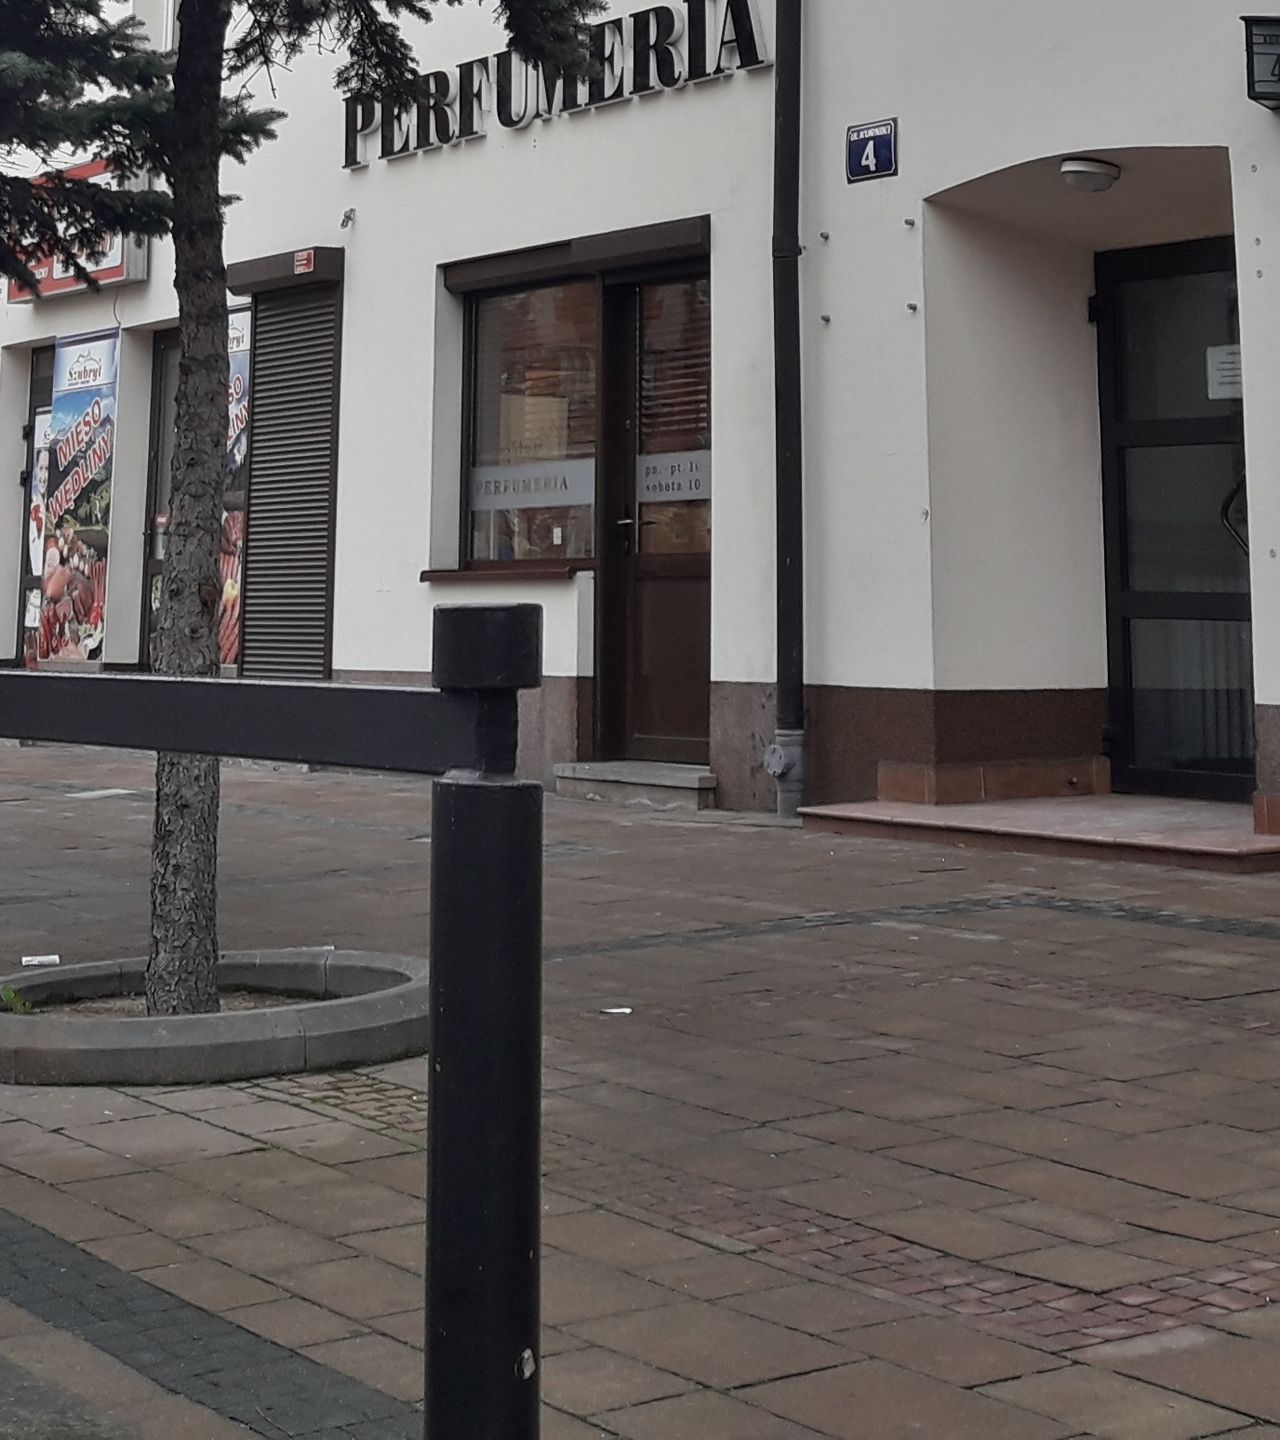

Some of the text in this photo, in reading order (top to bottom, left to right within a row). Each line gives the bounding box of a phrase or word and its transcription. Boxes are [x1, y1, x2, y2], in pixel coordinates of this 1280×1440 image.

[861, 139, 877, 172] 4
[56, 396, 103, 472] MIĘSO
[48, 425, 113, 523] WĘDLINY
[475, 475, 568, 496] PERFUMERIA
